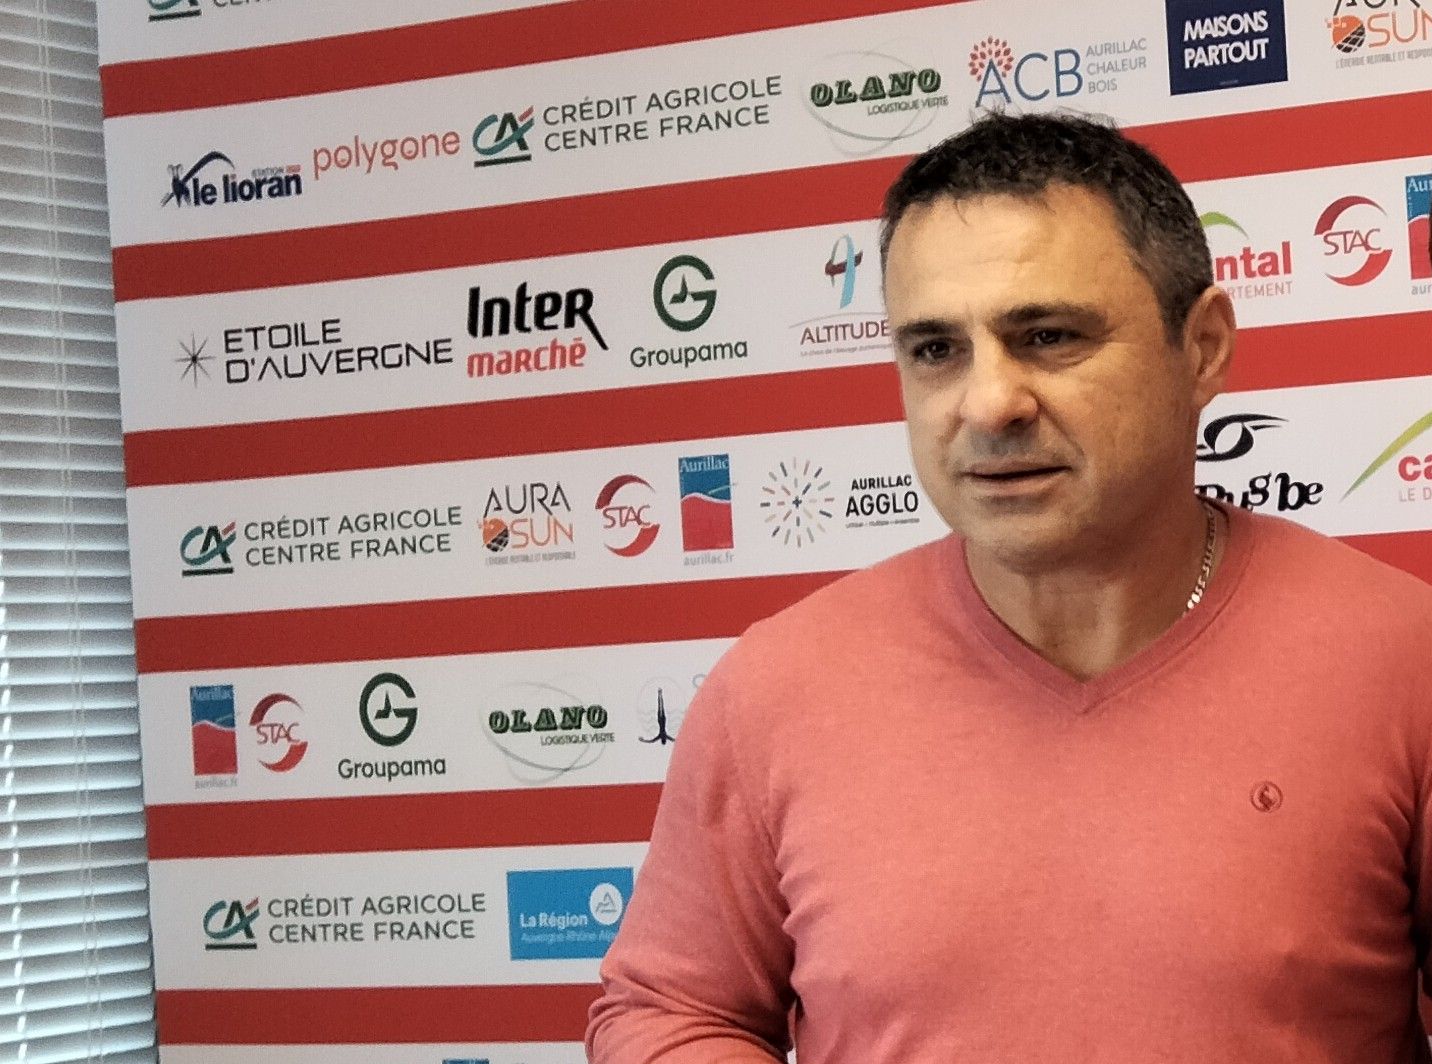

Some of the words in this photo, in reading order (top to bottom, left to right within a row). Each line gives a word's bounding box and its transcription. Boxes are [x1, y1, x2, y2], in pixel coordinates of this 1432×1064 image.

[1184, 10, 1269, 42] MAISONS
[1085, 38, 1147, 57] AURILLAC
[1184, 38, 1269, 69] PARTOUT
[975, 48, 1083, 107] ACB
[1087, 56, 1147, 76] CHALEUR
[543, 95, 637, 126] CRÉDIT
[646, 75, 782, 113] AGRICOLE
[810, 68, 942, 107] OLANO
[1088, 79, 1118, 94] BOIS
[544, 119, 649, 152] CENTRE
[660, 104, 770, 138] FRANCE
[313, 130, 460, 181] polygone
[193, 177, 217, 206] le
[223, 173, 302, 203] lioran
[1323, 229, 1381, 256] STAC
[1215, 241, 1292, 281] ntal
[1228, 281, 1292, 299] RTEMENT
[223, 319, 342, 353] ETOILE
[800, 319, 890, 345] ALTITUDE
[226, 338, 453, 384] D'AUVERGNE
[630, 340, 748, 368] Groupama
[679, 456, 729, 474] Aurillac
[851, 474, 912, 491] AURILLAC
[1400, 487, 1416, 502] LE
[483, 482, 571, 518] AURA
[845, 490, 919, 517] AGGLO
[244, 516, 330, 541] CRÉDIT
[338, 506, 462, 535] AGRICOLE
[602, 504, 653, 530] STAC
[511, 516, 574, 550] SUN
[246, 540, 342, 566] CENTRE
[350, 533, 452, 559] FRANCE
[683, 551, 735, 567] aurillac.fr
[488, 704, 608, 734] OLANO
[256, 722, 300, 745] STAC
[338, 757, 446, 781] Groupama
[267, 894, 354, 919] CRÉDIT
[361, 892, 486, 916] AGRICOLE
[269, 921, 364, 944] CENTRE
[373, 918, 475, 941] FRANCE
